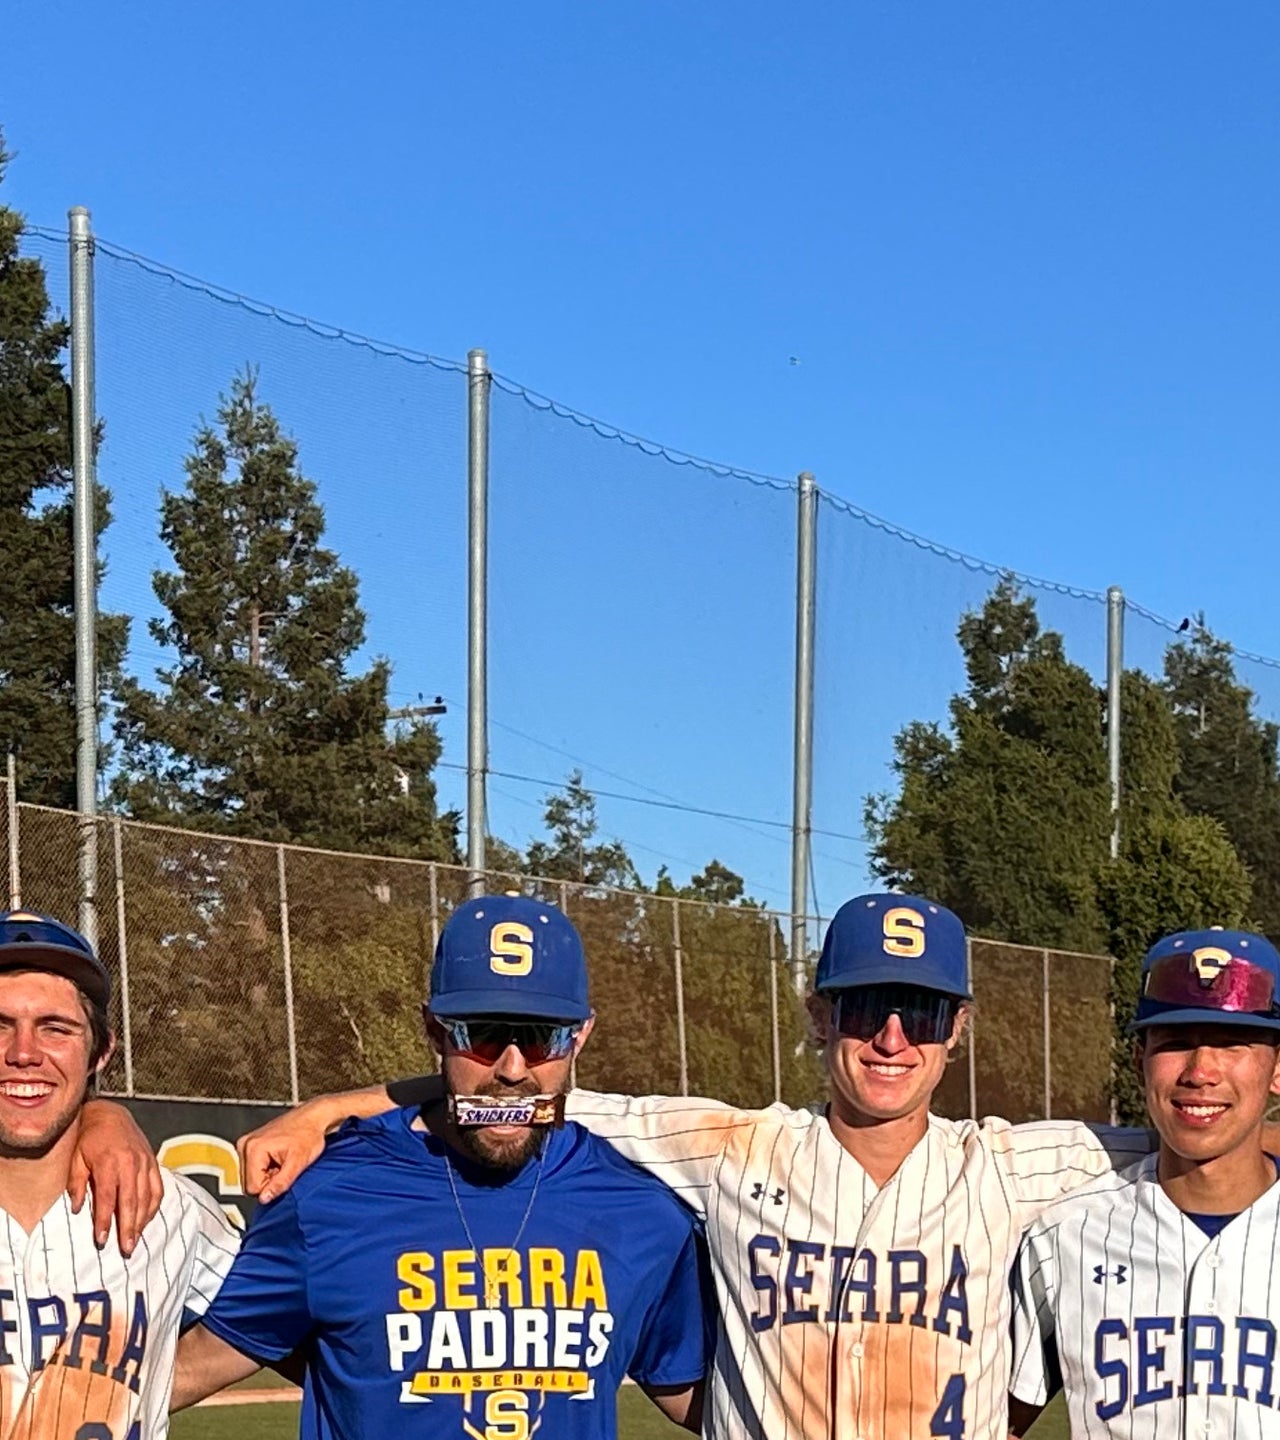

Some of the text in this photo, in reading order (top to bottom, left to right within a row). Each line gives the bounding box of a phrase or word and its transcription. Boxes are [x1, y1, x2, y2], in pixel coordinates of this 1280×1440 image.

[490, 922, 533, 976] S
[882, 907, 925, 957] S
[465, 1108, 532, 1123] SNICKERS
[396, 1248, 608, 1312] SERRA
[747, 1233, 973, 1346] SERRA
[385, 1308, 614, 1372] PADRES
[429, 1373, 575, 1388] BASEBALL
